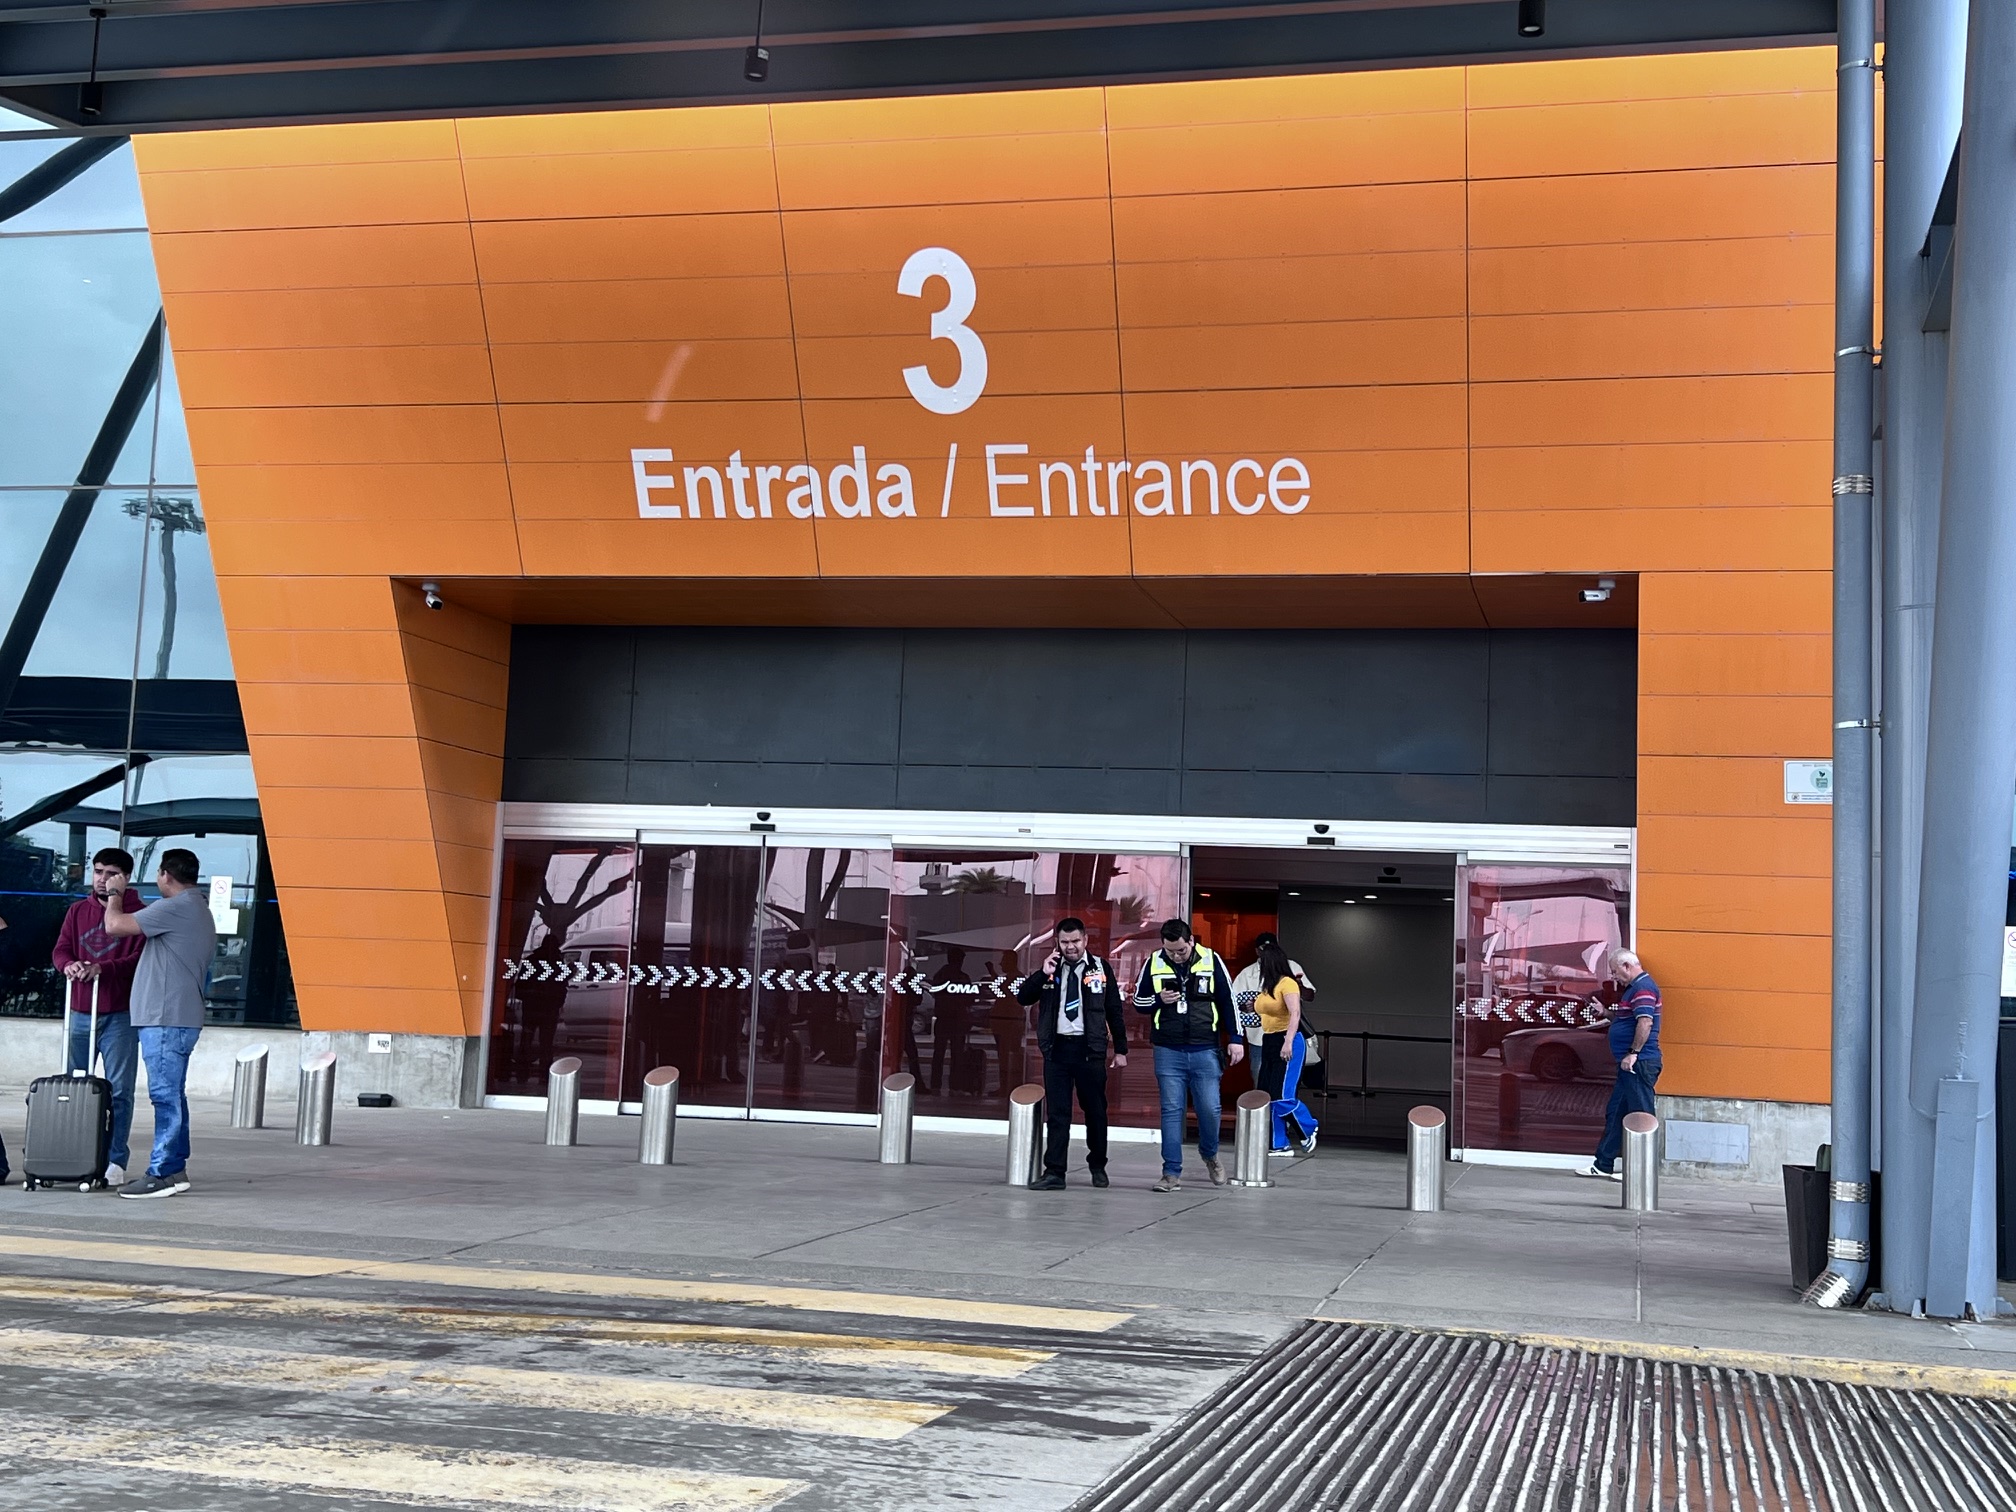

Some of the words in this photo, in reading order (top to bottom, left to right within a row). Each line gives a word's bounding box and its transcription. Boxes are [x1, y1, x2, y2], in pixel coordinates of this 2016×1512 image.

[896, 246, 989, 415] 3
[630, 446, 918, 520] Entrada
[940, 442, 959, 518] /
[984, 443, 1312, 518] Entrance
[946, 983, 980, 994] OMA
